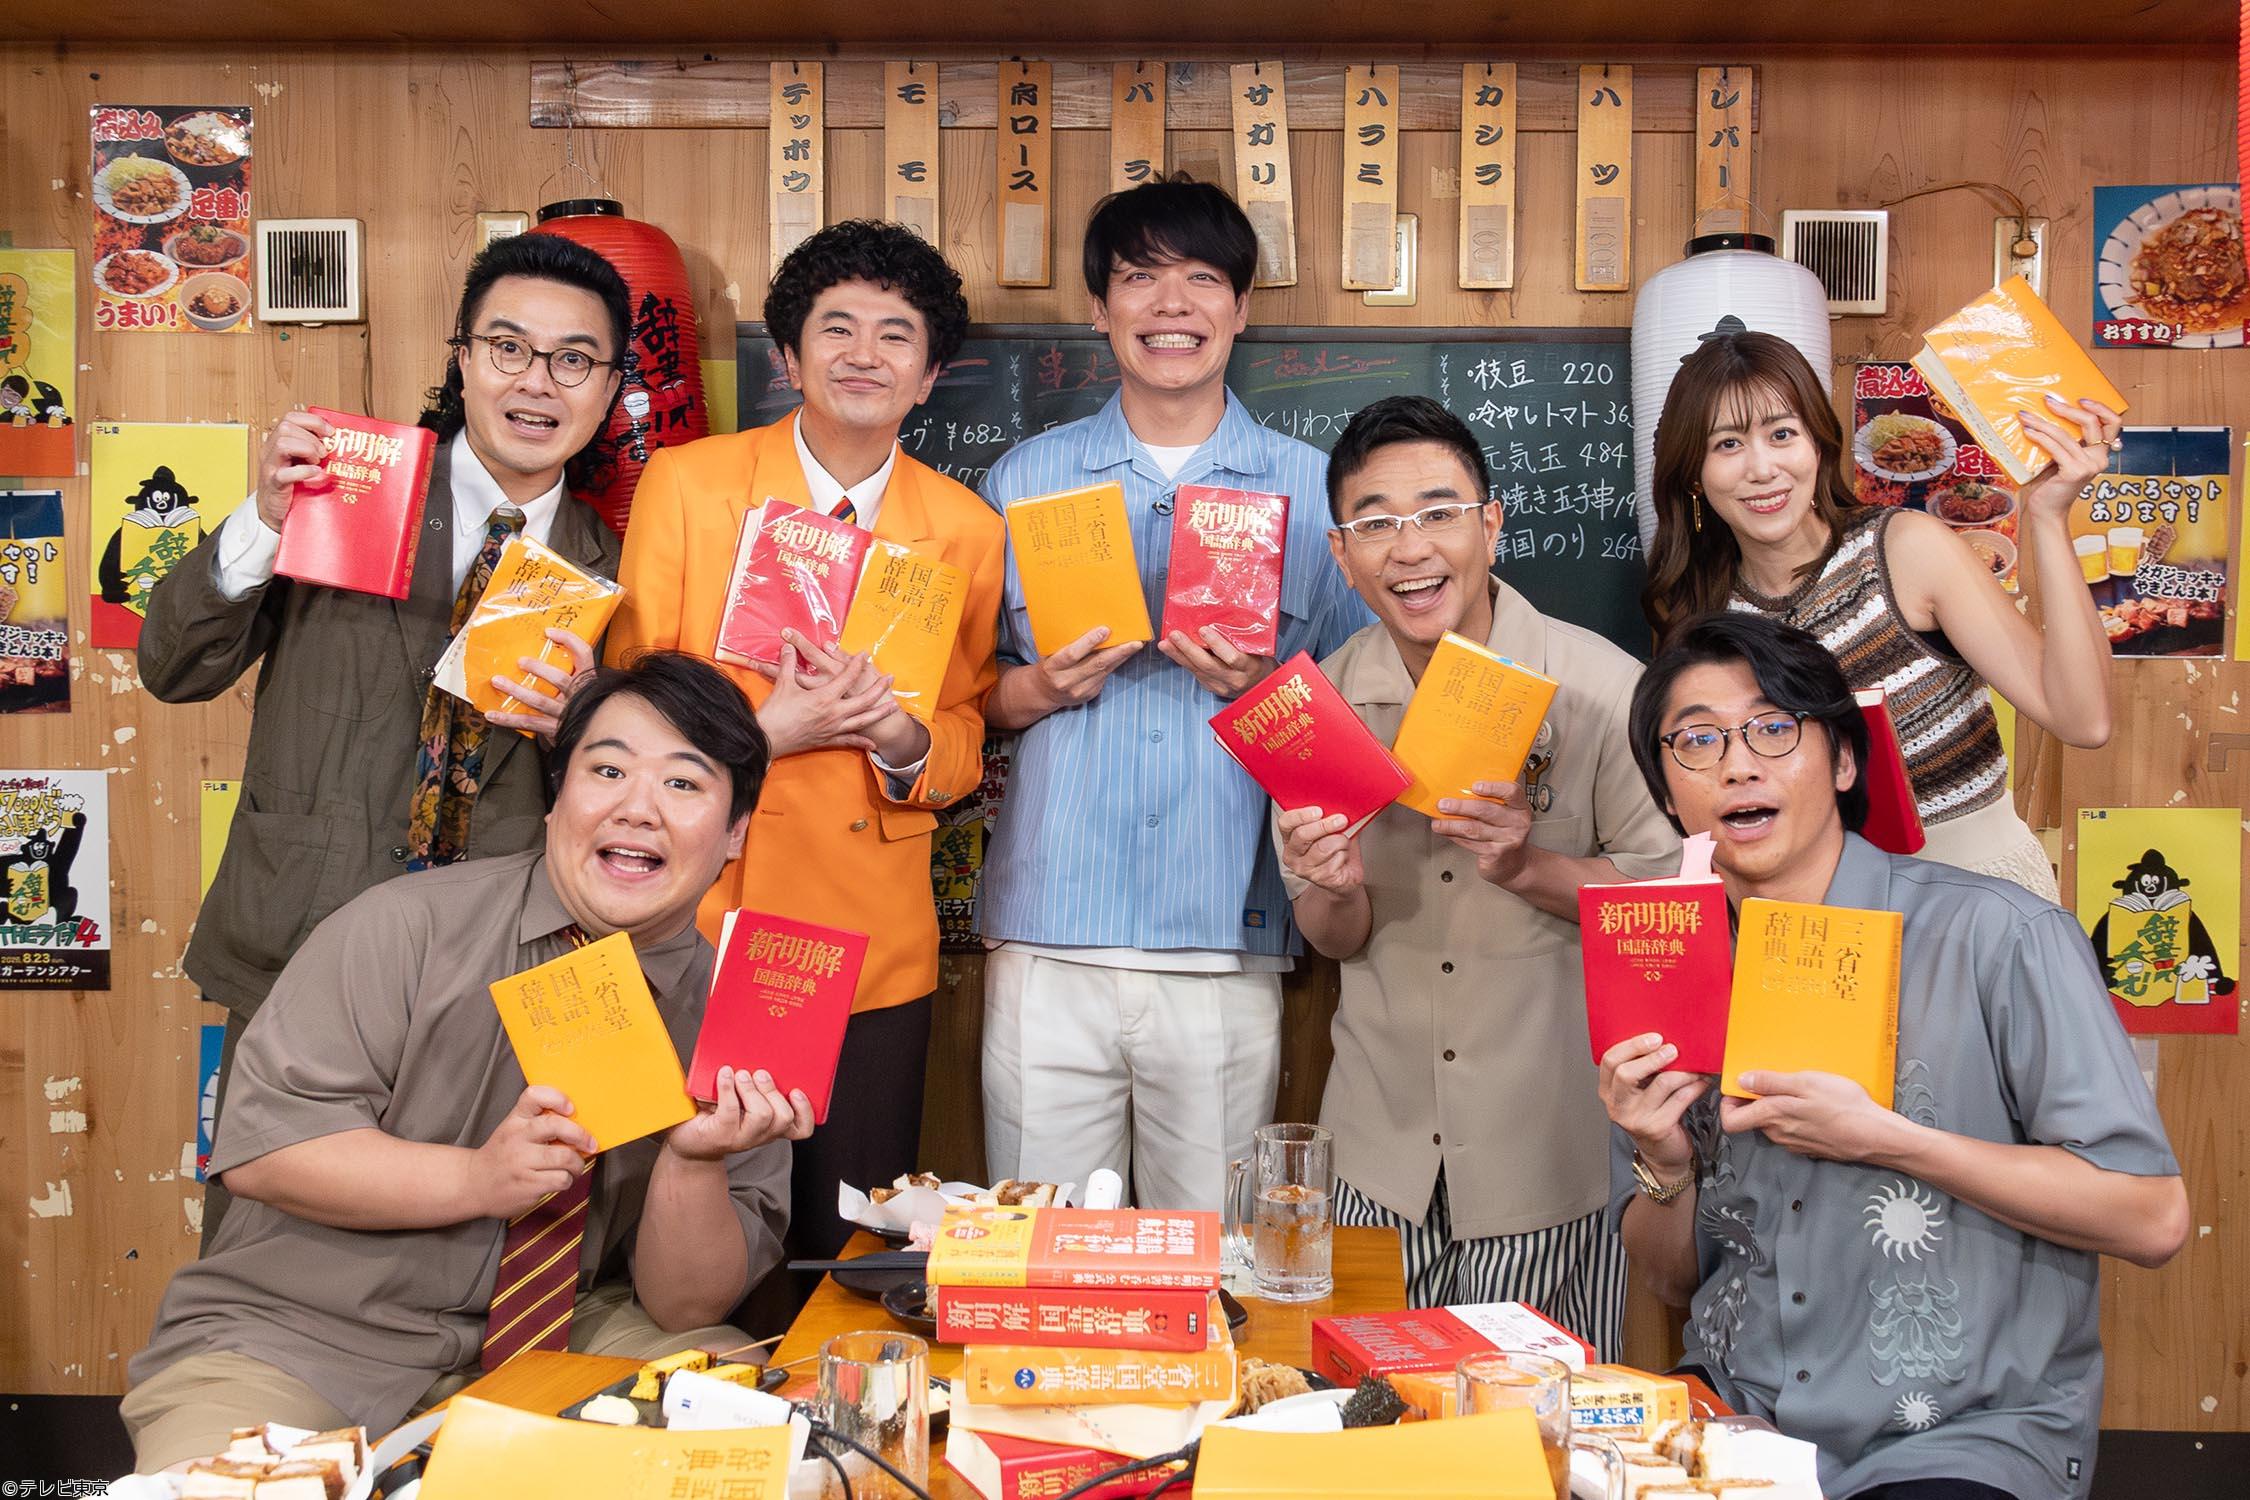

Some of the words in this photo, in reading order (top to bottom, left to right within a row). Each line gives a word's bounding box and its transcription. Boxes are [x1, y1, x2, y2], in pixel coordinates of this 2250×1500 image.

[782, 84, 812, 193] テッポウ
[897, 83, 927, 183] モモ
[1008, 82, 1039, 193] 肩ロース
[1124, 80, 1154, 181] バラ
[1244, 84, 1277, 187] サガリ
[1356, 87, 1389, 186] ハラミ
[1473, 85, 1504, 187] カシラ
[1589, 86, 1620, 187] ハツ
[1709, 87, 1741, 189] レバー
[190, 188, 251, 221] 定番!
[95, 300, 178, 328] うまい!
[2103, 323, 2184, 340] おすすめ!
[1474, 358, 1535, 391] 枝豆
[1563, 362, 1613, 385] 220
[1856, 365, 1928, 399] 煮込み
[1476, 399, 1599, 430] 冷やしトマト
[1604, 401, 1635, 429] 36
[1579, 442, 1629, 469] 484
[1026, 511, 1055, 552] 辞典
[1053, 502, 1082, 549] 国語
[1080, 498, 1113, 562] 三省堂
[1188, 499, 1273, 537] 新明解
[2090, 500, 2200, 523] あります!
[770, 519, 855, 563] 新明解
[1199, 532, 1255, 553] 国語辞典
[1600, 532, 1641, 560] 264
[879, 556, 909, 600] 辞典
[901, 562, 934, 609] 国語
[2133, 578, 2218, 602] やきとん3本!
[2136, 564, 2226, 587] メガジョッキ+
[920, 571, 957, 637] 三省堂
[1443, 656, 1477, 705] 辞典
[1469, 666, 1506, 716] 国語
[1231, 673, 1314, 745] 新明解
[1263, 711, 1316, 753] 国語辞典
[1492, 678, 1534, 748] 三省堂
[1598, 901, 1704, 936] 新明解
[1763, 910, 1794, 965] 辞典
[1795, 914, 1828, 970] 国語
[744, 927, 846, 981] 新明解
[1616, 937, 1686, 957] 国語辞典
[1832, 919, 1865, 1002] 三省堂
[549, 966, 592, 1022] 国語
[583, 953, 633, 1033] 三省堂
[752, 966, 818, 997] 国語辞典
[519, 979, 557, 1032] 辞典
[945, 1300, 1032, 1333] 新明解
[1038, 1304, 1152, 1336] 国語辞典
[1038, 1363, 1219, 1391] 三省堂国語辞典
